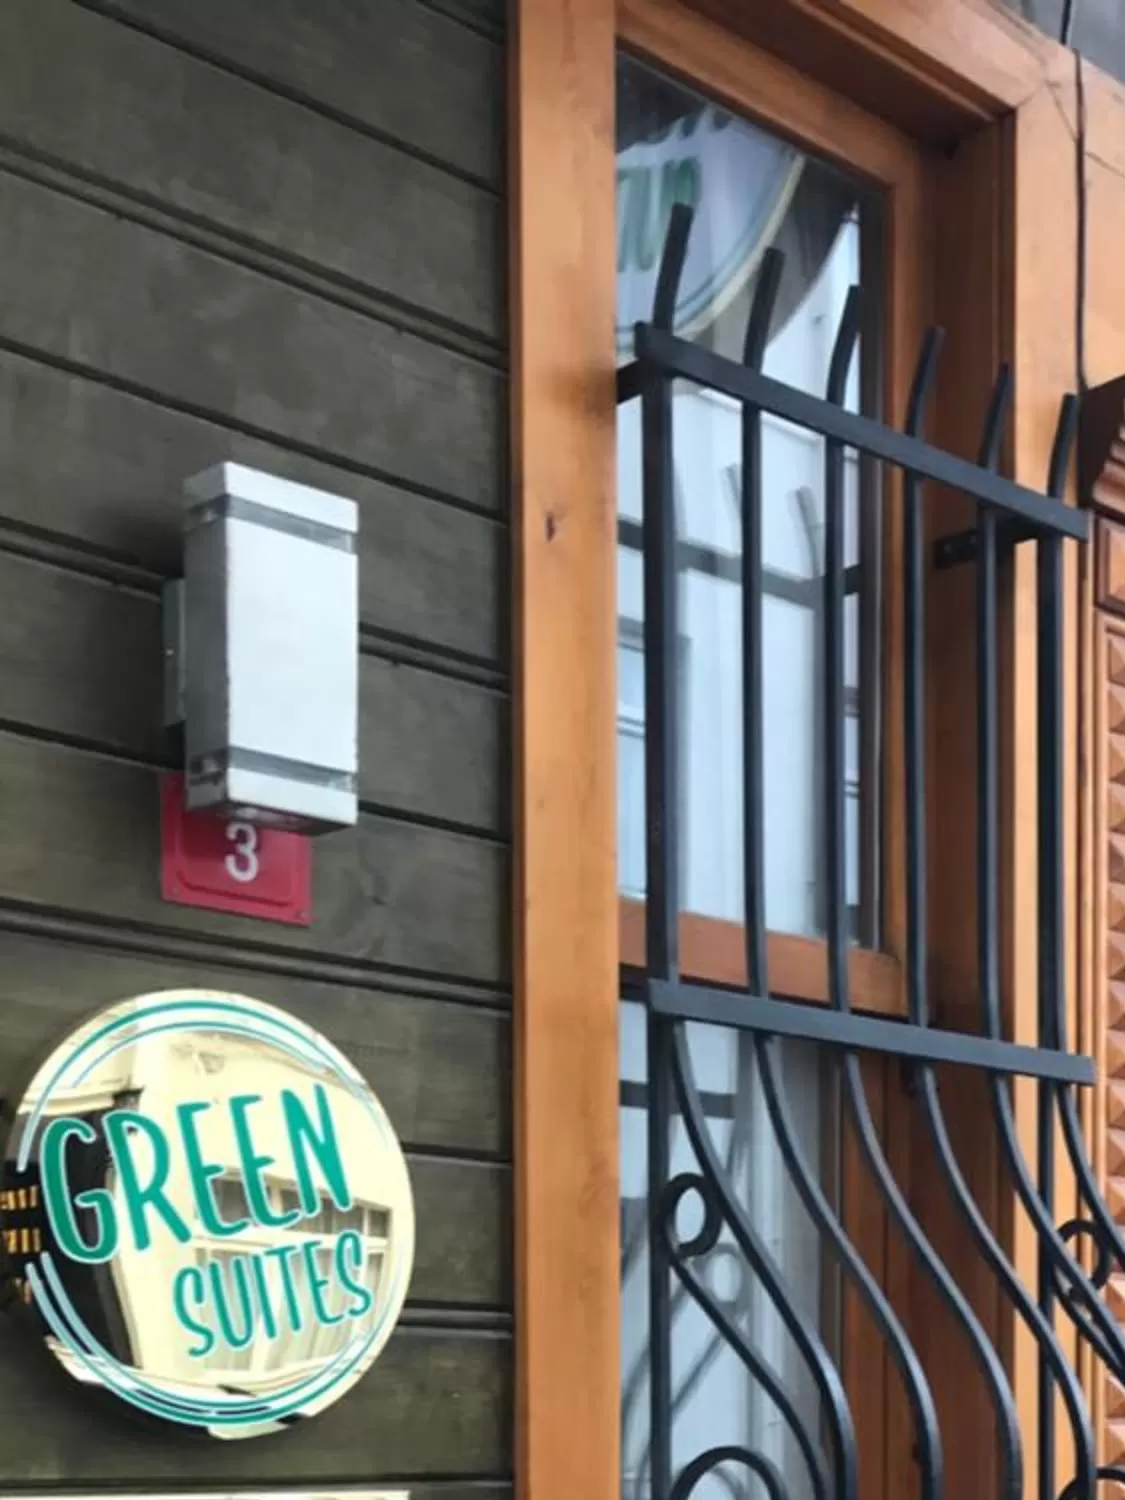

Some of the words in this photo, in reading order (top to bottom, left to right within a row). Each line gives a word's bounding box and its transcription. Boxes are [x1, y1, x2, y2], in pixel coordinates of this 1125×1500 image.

[225, 822, 259, 882] 3
[40, 1083, 354, 1264] GREEN
[172, 1231, 373, 1358] SUITES
